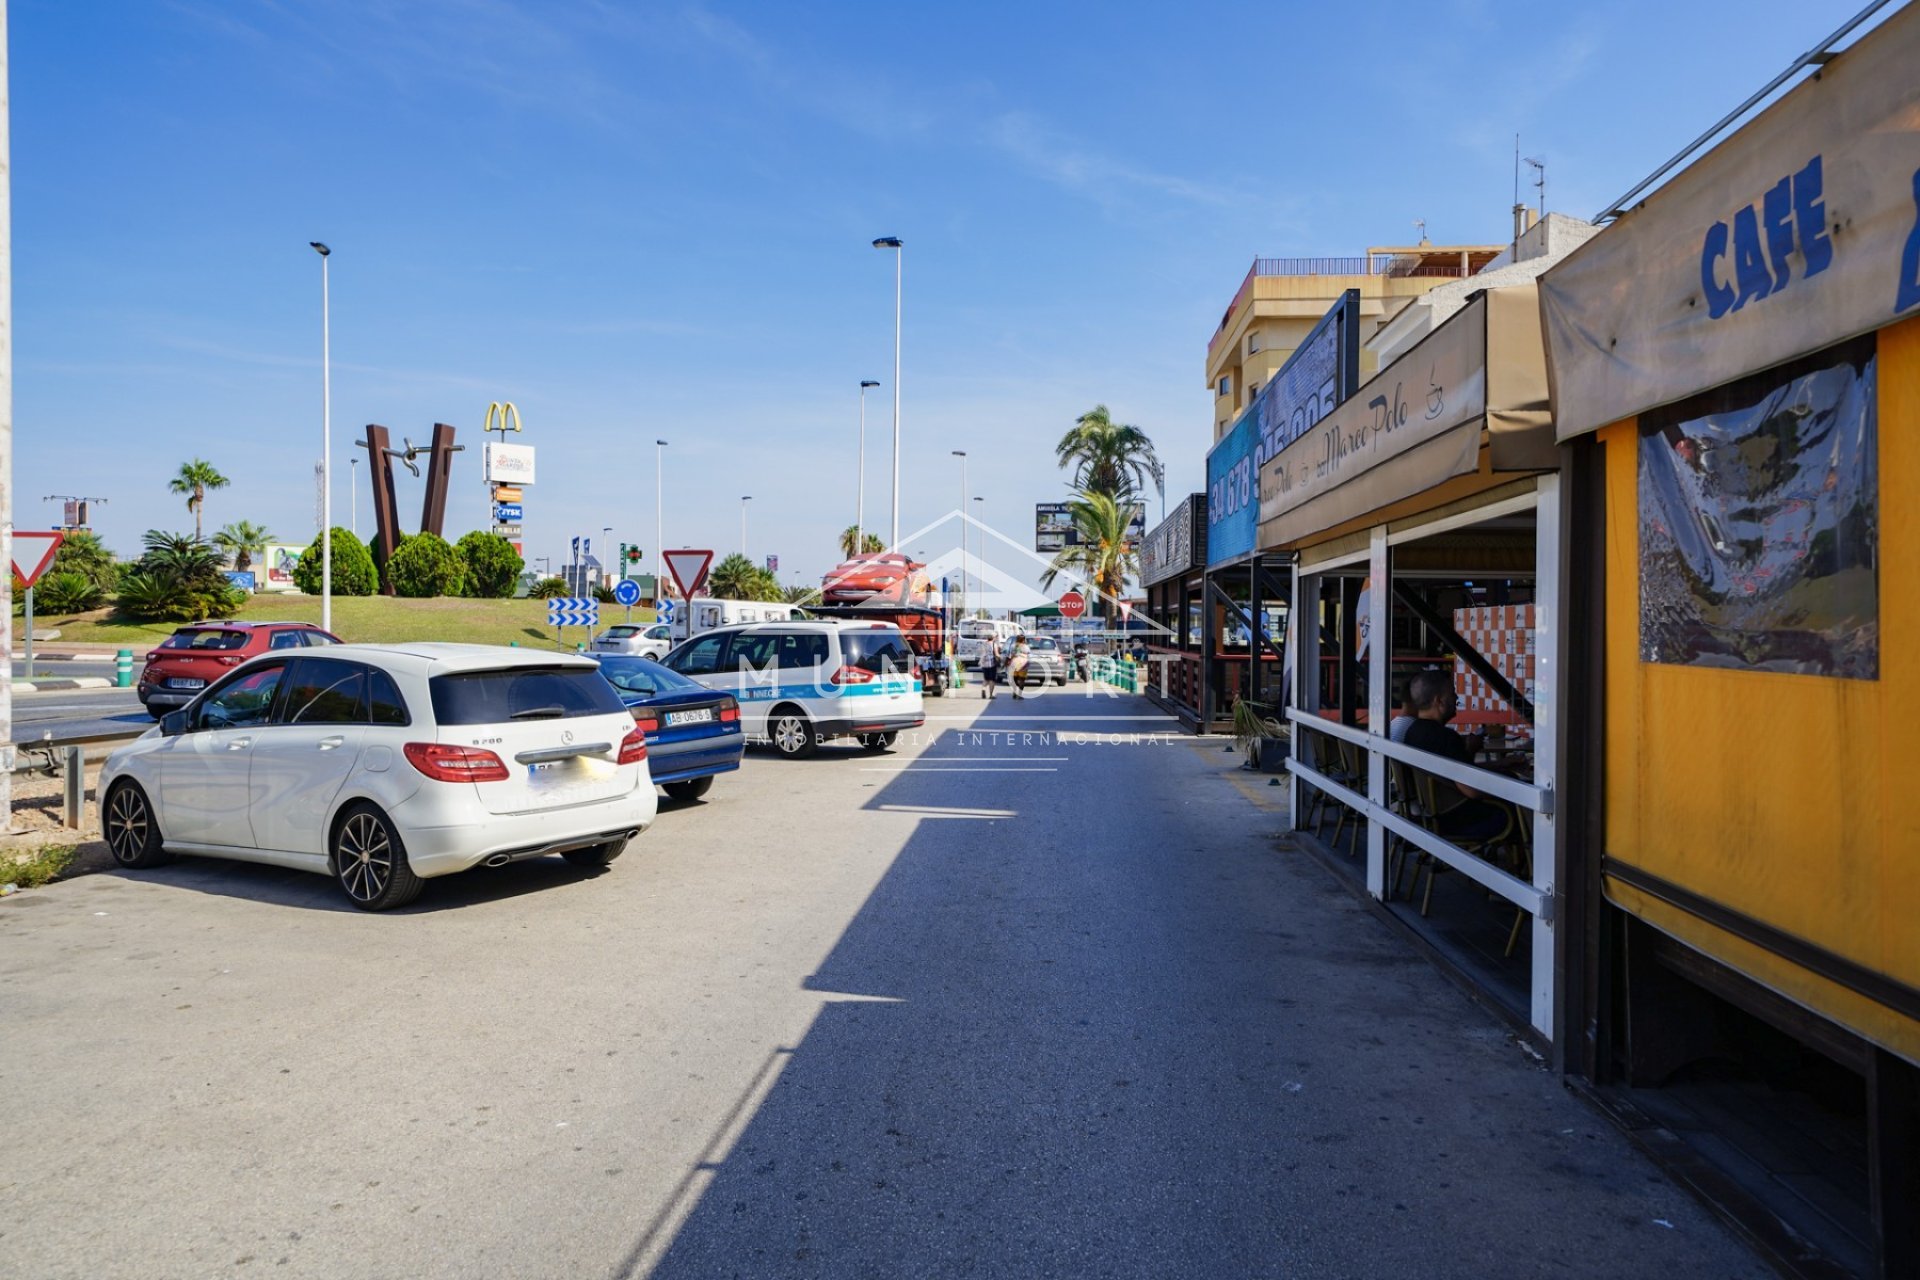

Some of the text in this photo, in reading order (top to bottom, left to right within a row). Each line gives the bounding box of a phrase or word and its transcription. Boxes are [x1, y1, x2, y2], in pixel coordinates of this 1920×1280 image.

[1701, 154, 1833, 320] CAFE
[1369, 382, 1408, 452] Polo
[502, 507, 521, 516] JYSK
[1227, 455, 1250, 516] 678
[1060, 601, 1084, 609] STOP
